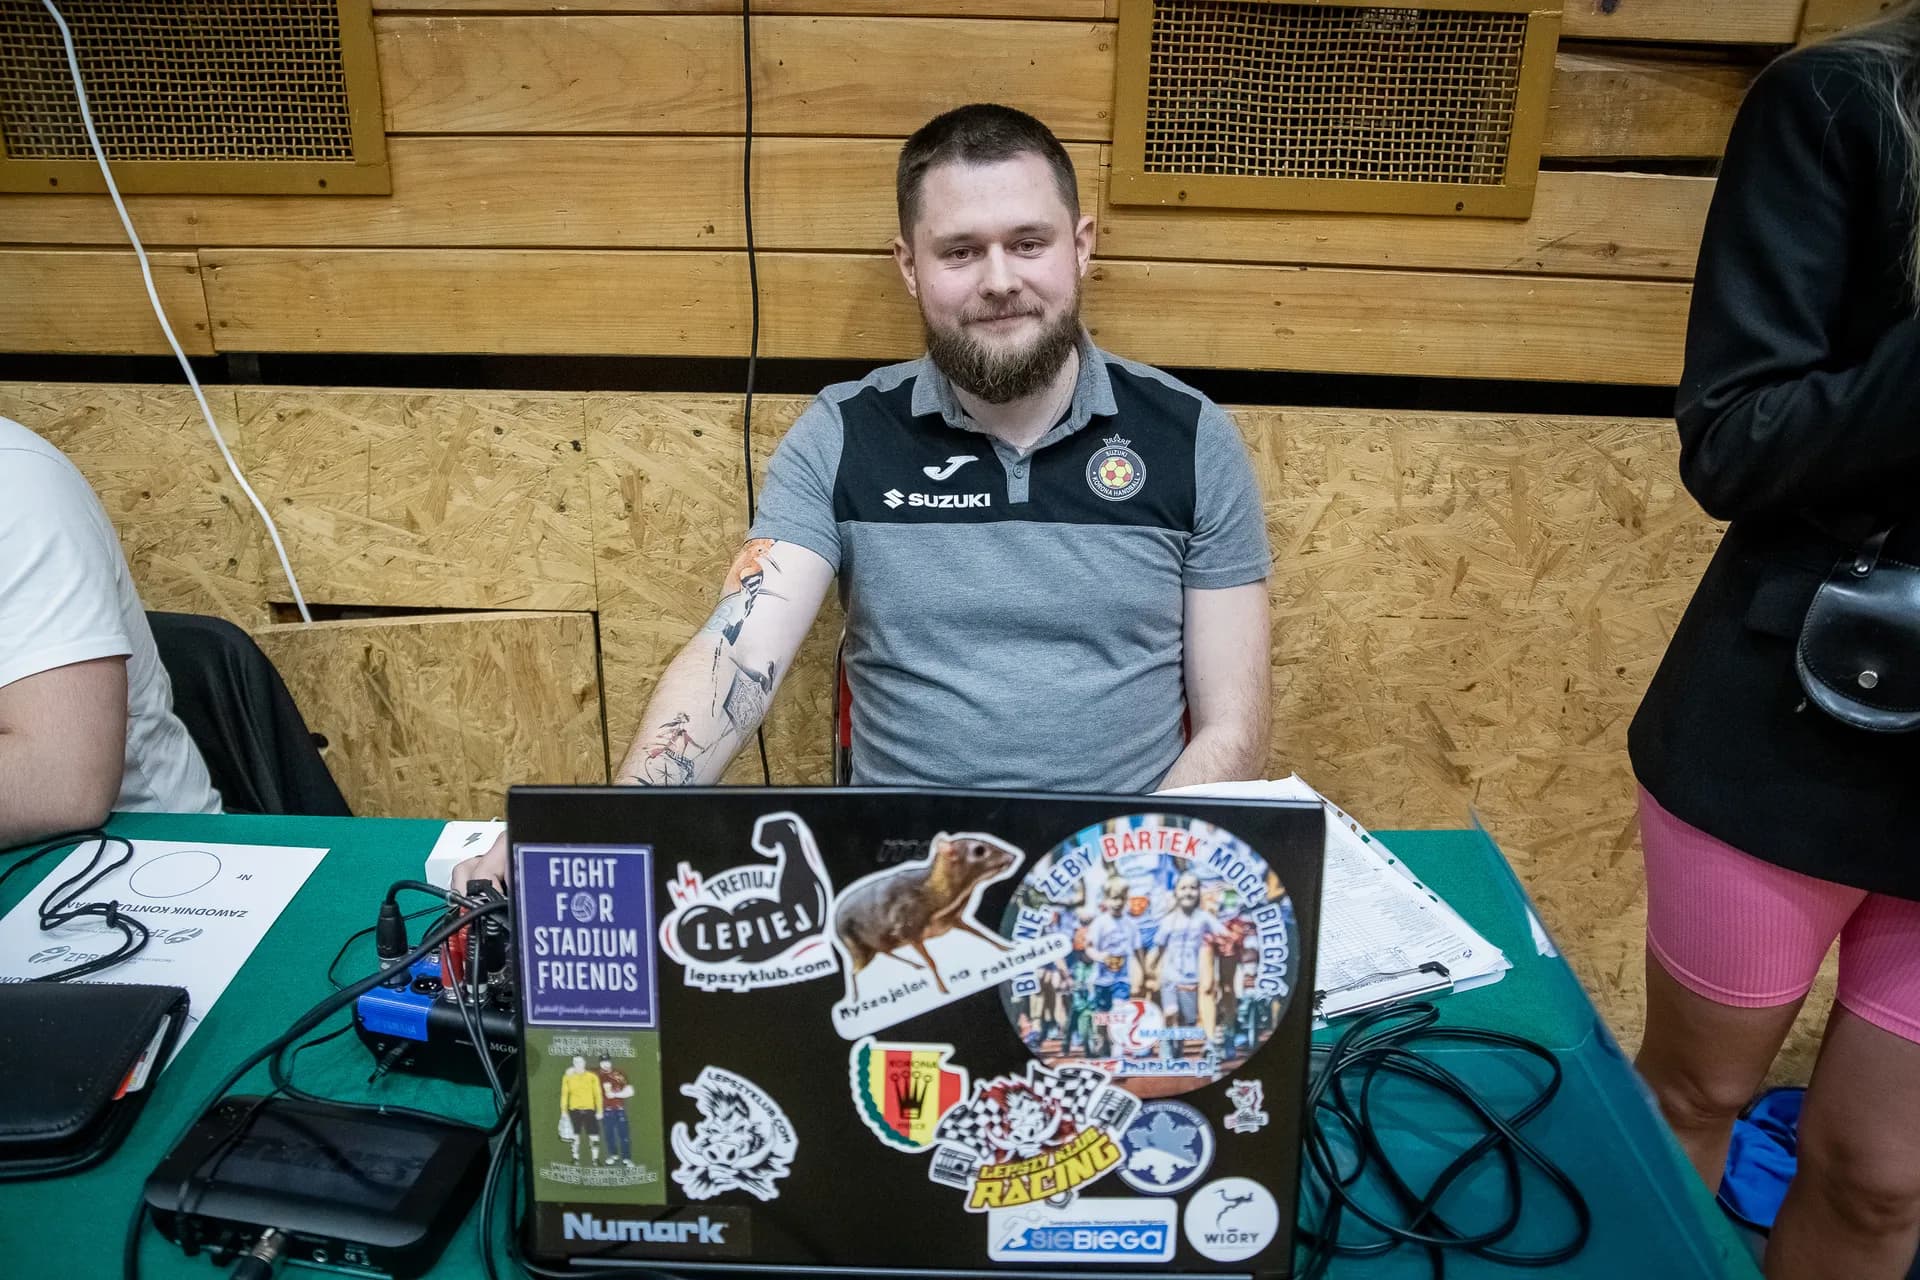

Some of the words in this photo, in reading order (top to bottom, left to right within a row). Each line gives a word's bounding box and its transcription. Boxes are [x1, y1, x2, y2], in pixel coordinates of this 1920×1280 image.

[1106, 450, 1128, 458] SUZUKI
[908, 493, 991, 508] SUZUKI
[1092, 476, 1113, 496] KORONA
[1114, 478, 1140, 497] HANDBALL
[1104, 830, 1201, 857] BARTEK
[236, 872, 253, 881] Nr
[549, 857, 617, 889] FIGHT
[705, 870, 776, 901] TRENUJ
[174, 906, 249, 918] ZAWODNIK
[696, 903, 813, 951] LEPIEJ
[534, 926, 638, 958] STADIUM
[537, 961, 638, 992] FRIENDS
[690, 957, 832, 987] lepszyklub.com
[950, 968, 971, 984] na
[979, 1154, 1050, 1180] LEPSZY
[1054, 1125, 1101, 1165] KLUB
[969, 1134, 1122, 1209] RACING
[563, 1212, 726, 1244] Numark
